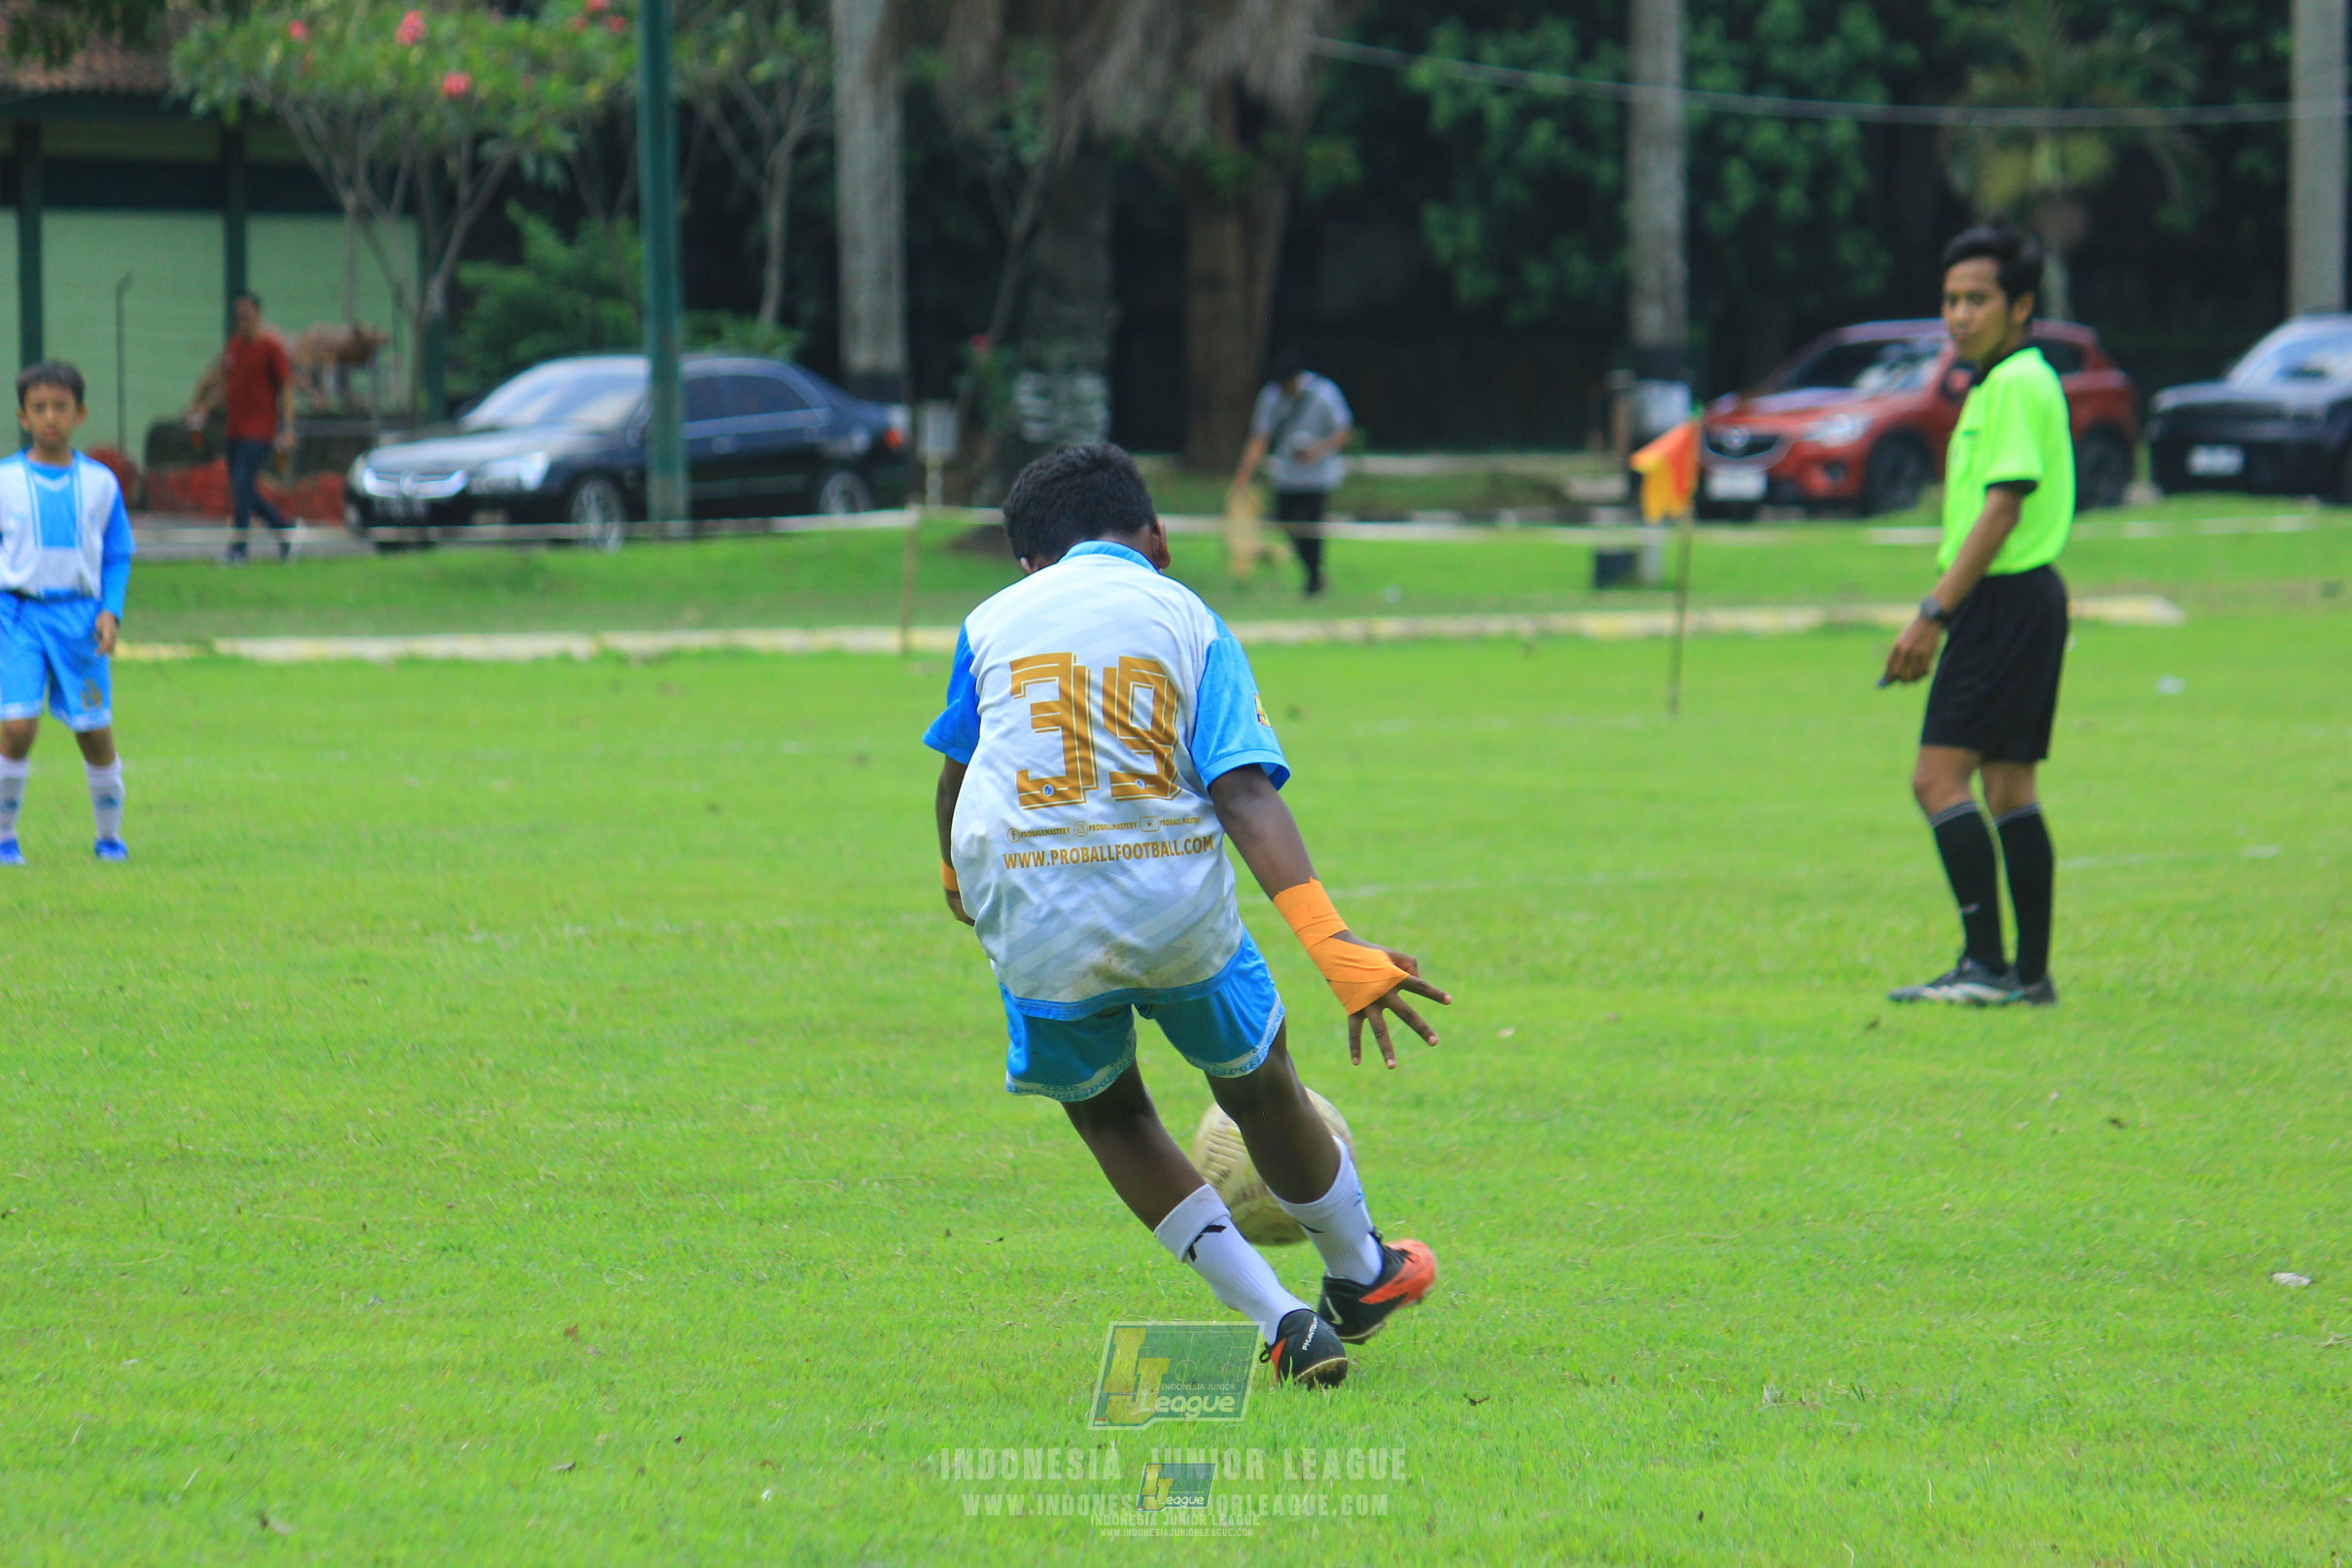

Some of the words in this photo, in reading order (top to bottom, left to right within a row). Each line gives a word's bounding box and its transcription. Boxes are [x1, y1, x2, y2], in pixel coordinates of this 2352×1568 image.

[1010, 652, 1181, 811] 39
[1089, 822, 1138, 832] PROBALLMASTERY
[1002, 835, 1213, 869] WWW.PROBALLFOOTBALL.COM
